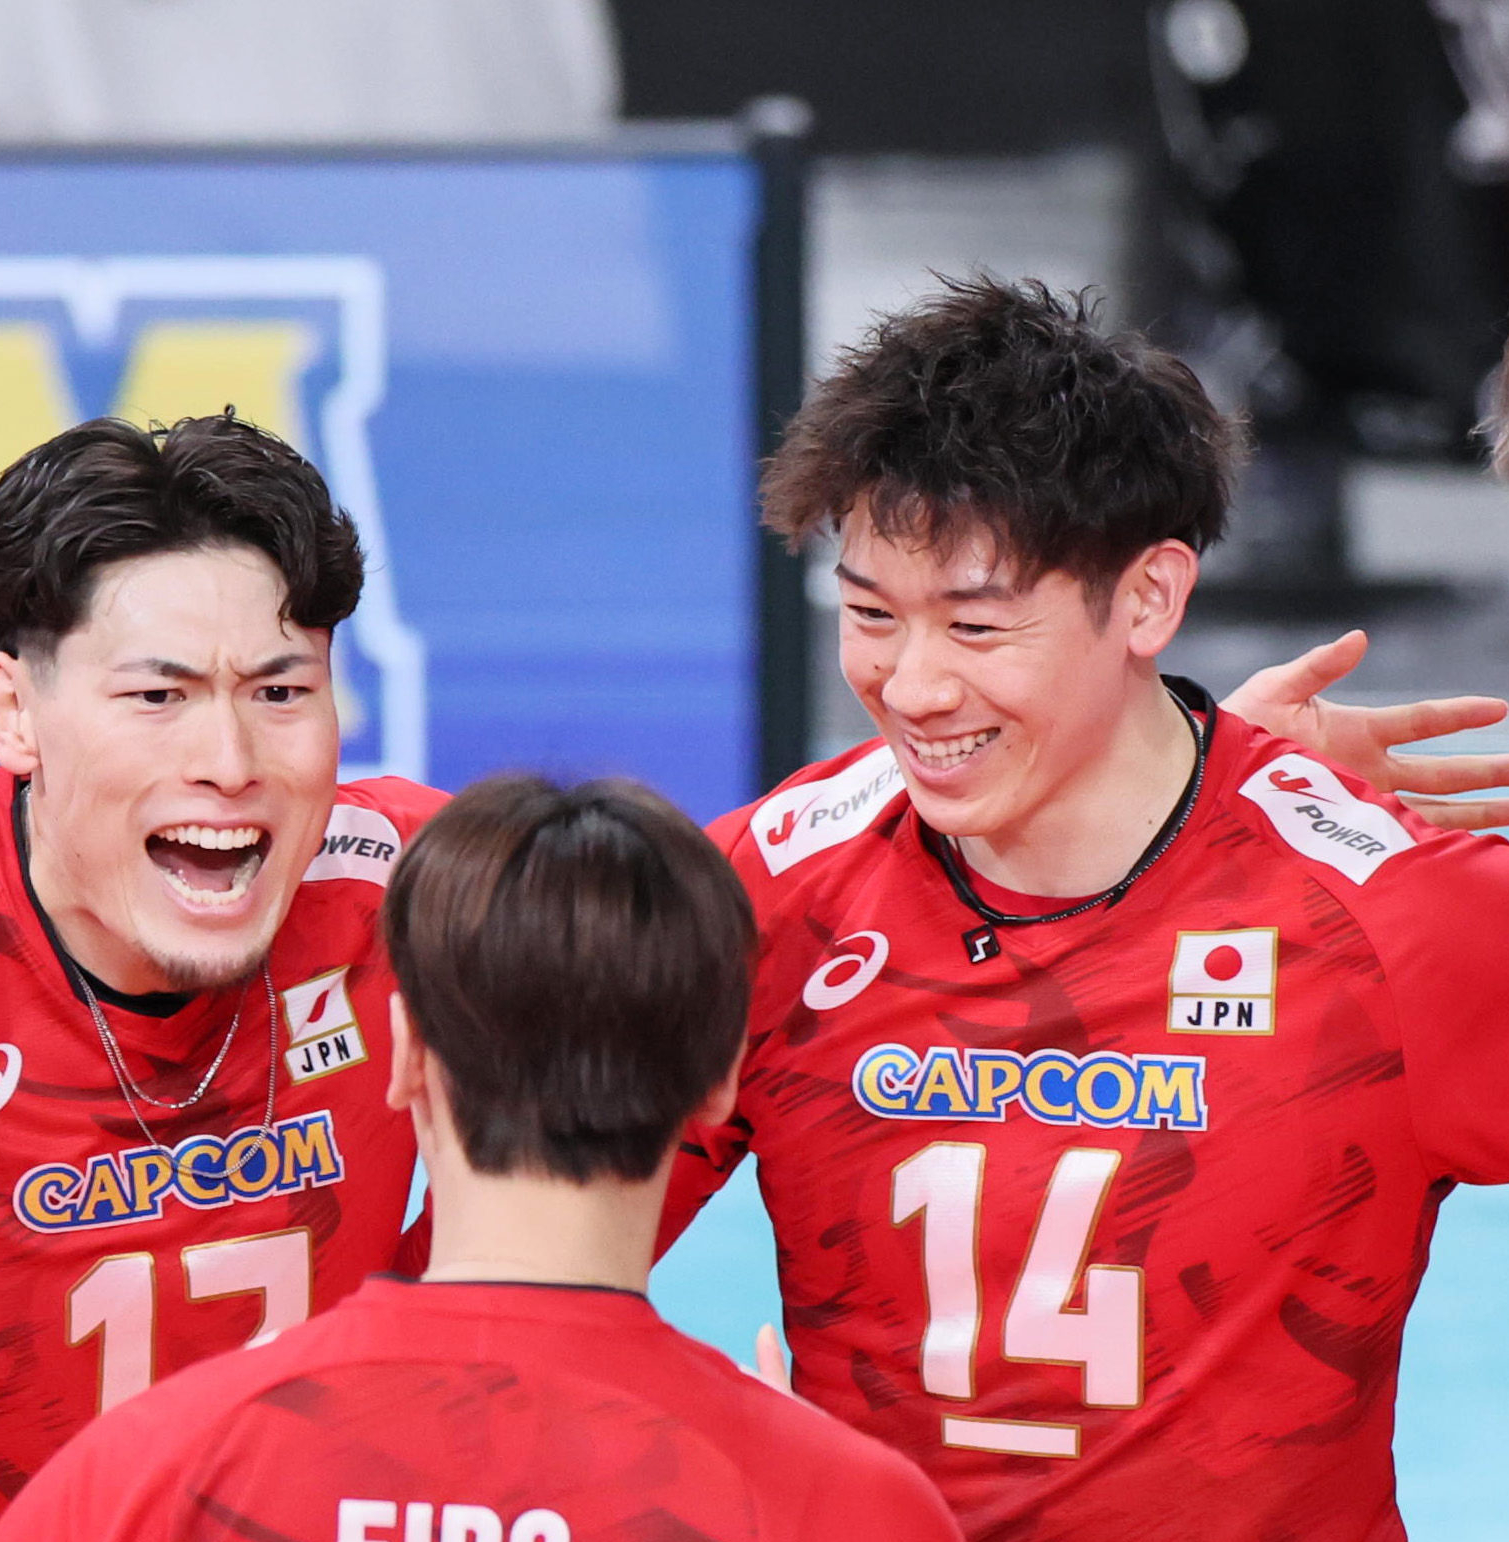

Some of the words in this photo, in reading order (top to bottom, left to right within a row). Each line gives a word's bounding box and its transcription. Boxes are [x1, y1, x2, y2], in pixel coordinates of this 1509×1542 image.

[315, 834, 396, 862] WER
[1294, 804, 1388, 857] POWER
[1186, 1000, 1254, 1028] JPN
[299, 1034, 352, 1075] JPN
[855, 1046, 1206, 1129] CAPCOM
[16, 1112, 344, 1230] CAPCOM
[891, 1141, 1145, 1410] 14
